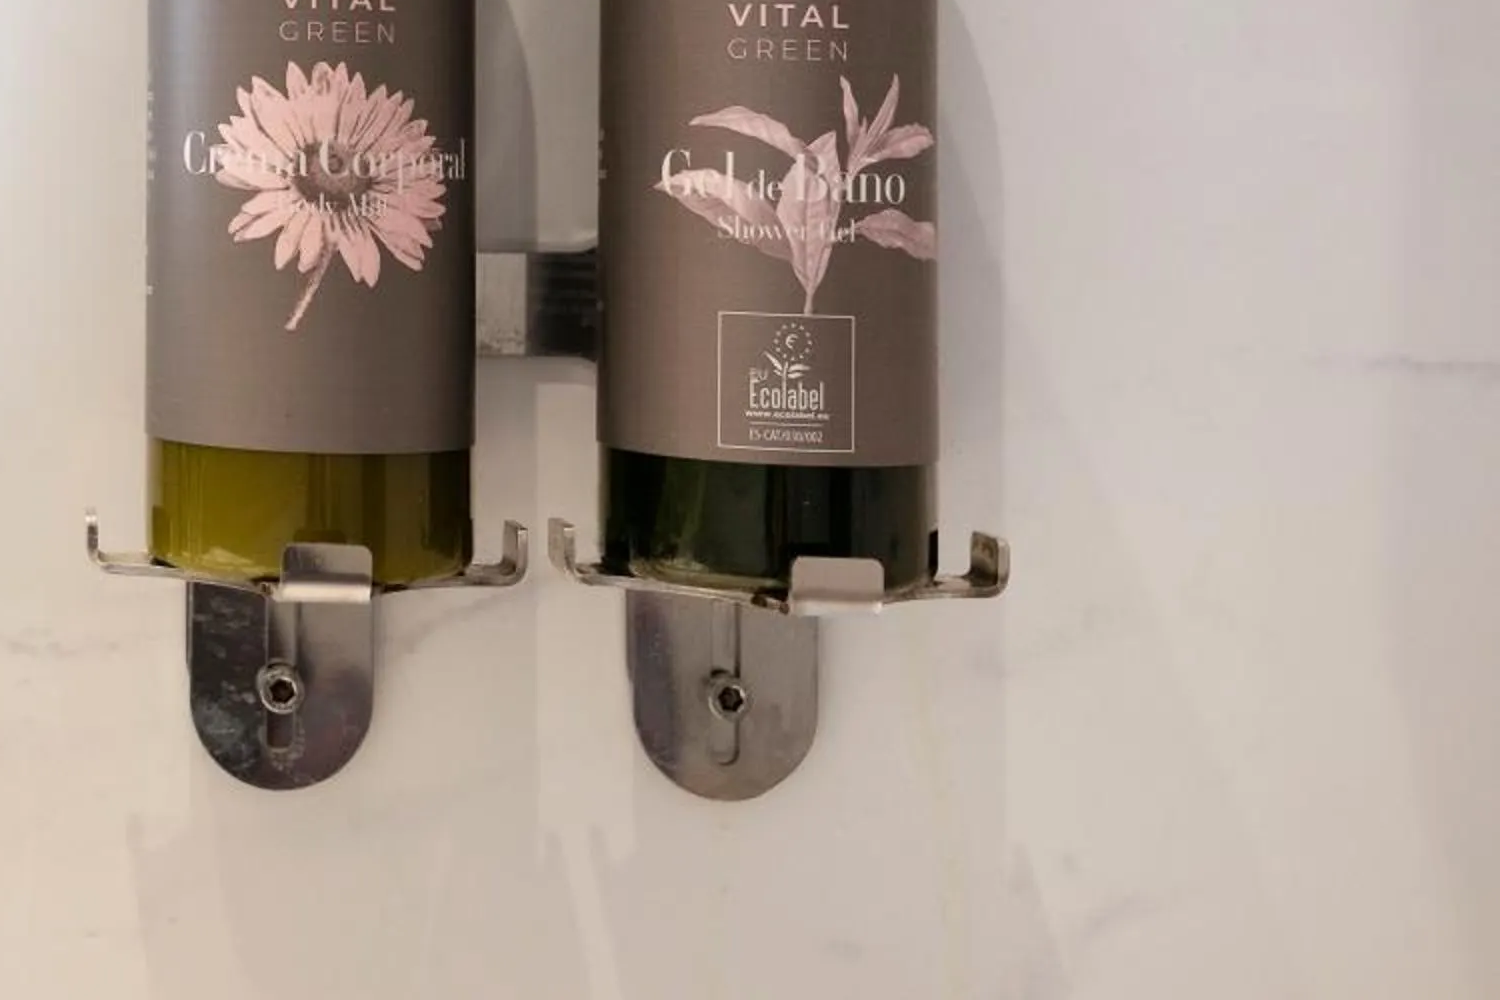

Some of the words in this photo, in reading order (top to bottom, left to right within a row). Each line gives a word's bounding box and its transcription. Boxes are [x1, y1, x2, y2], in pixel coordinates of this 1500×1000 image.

[727, 2, 850, 30] VITAL
[278, 19, 396, 44] GREEN
[726, 37, 848, 62] GREEN
[660, 148, 735, 201] Gel
[747, 168, 783, 201] de
[749, 379, 825, 412] Ecolabel
